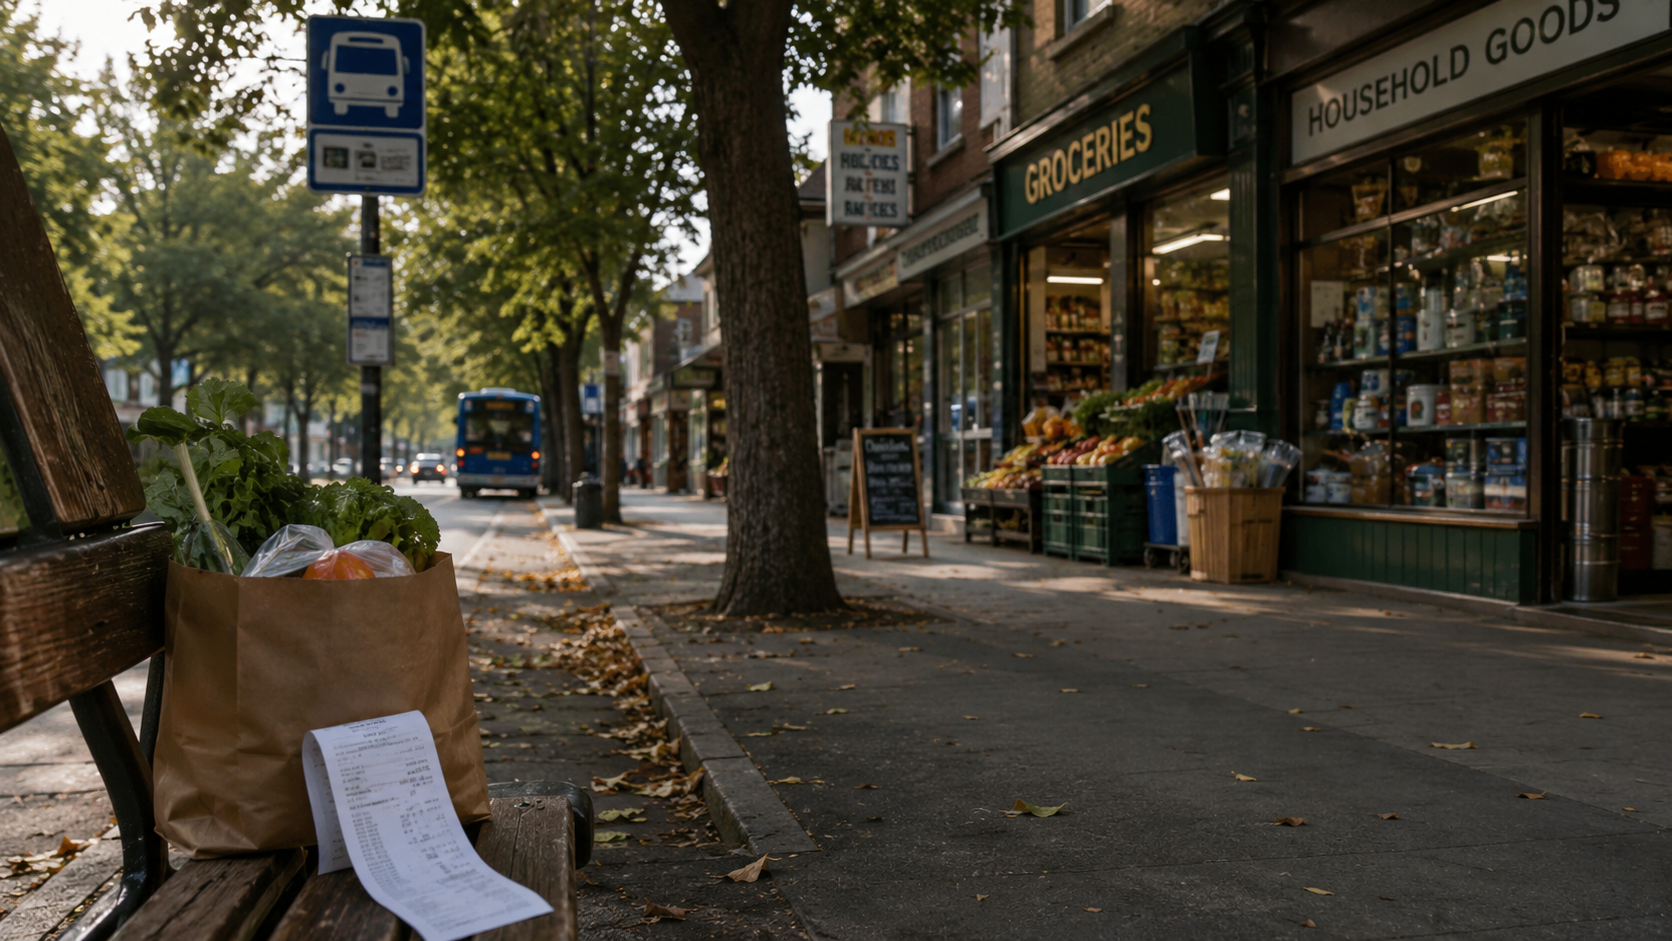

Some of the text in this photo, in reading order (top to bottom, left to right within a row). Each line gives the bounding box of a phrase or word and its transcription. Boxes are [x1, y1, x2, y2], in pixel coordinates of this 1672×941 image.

[1309, 0, 1620, 136] HOUSEHOLD GOODS
[1025, 103, 1153, 205] GROCERIES
